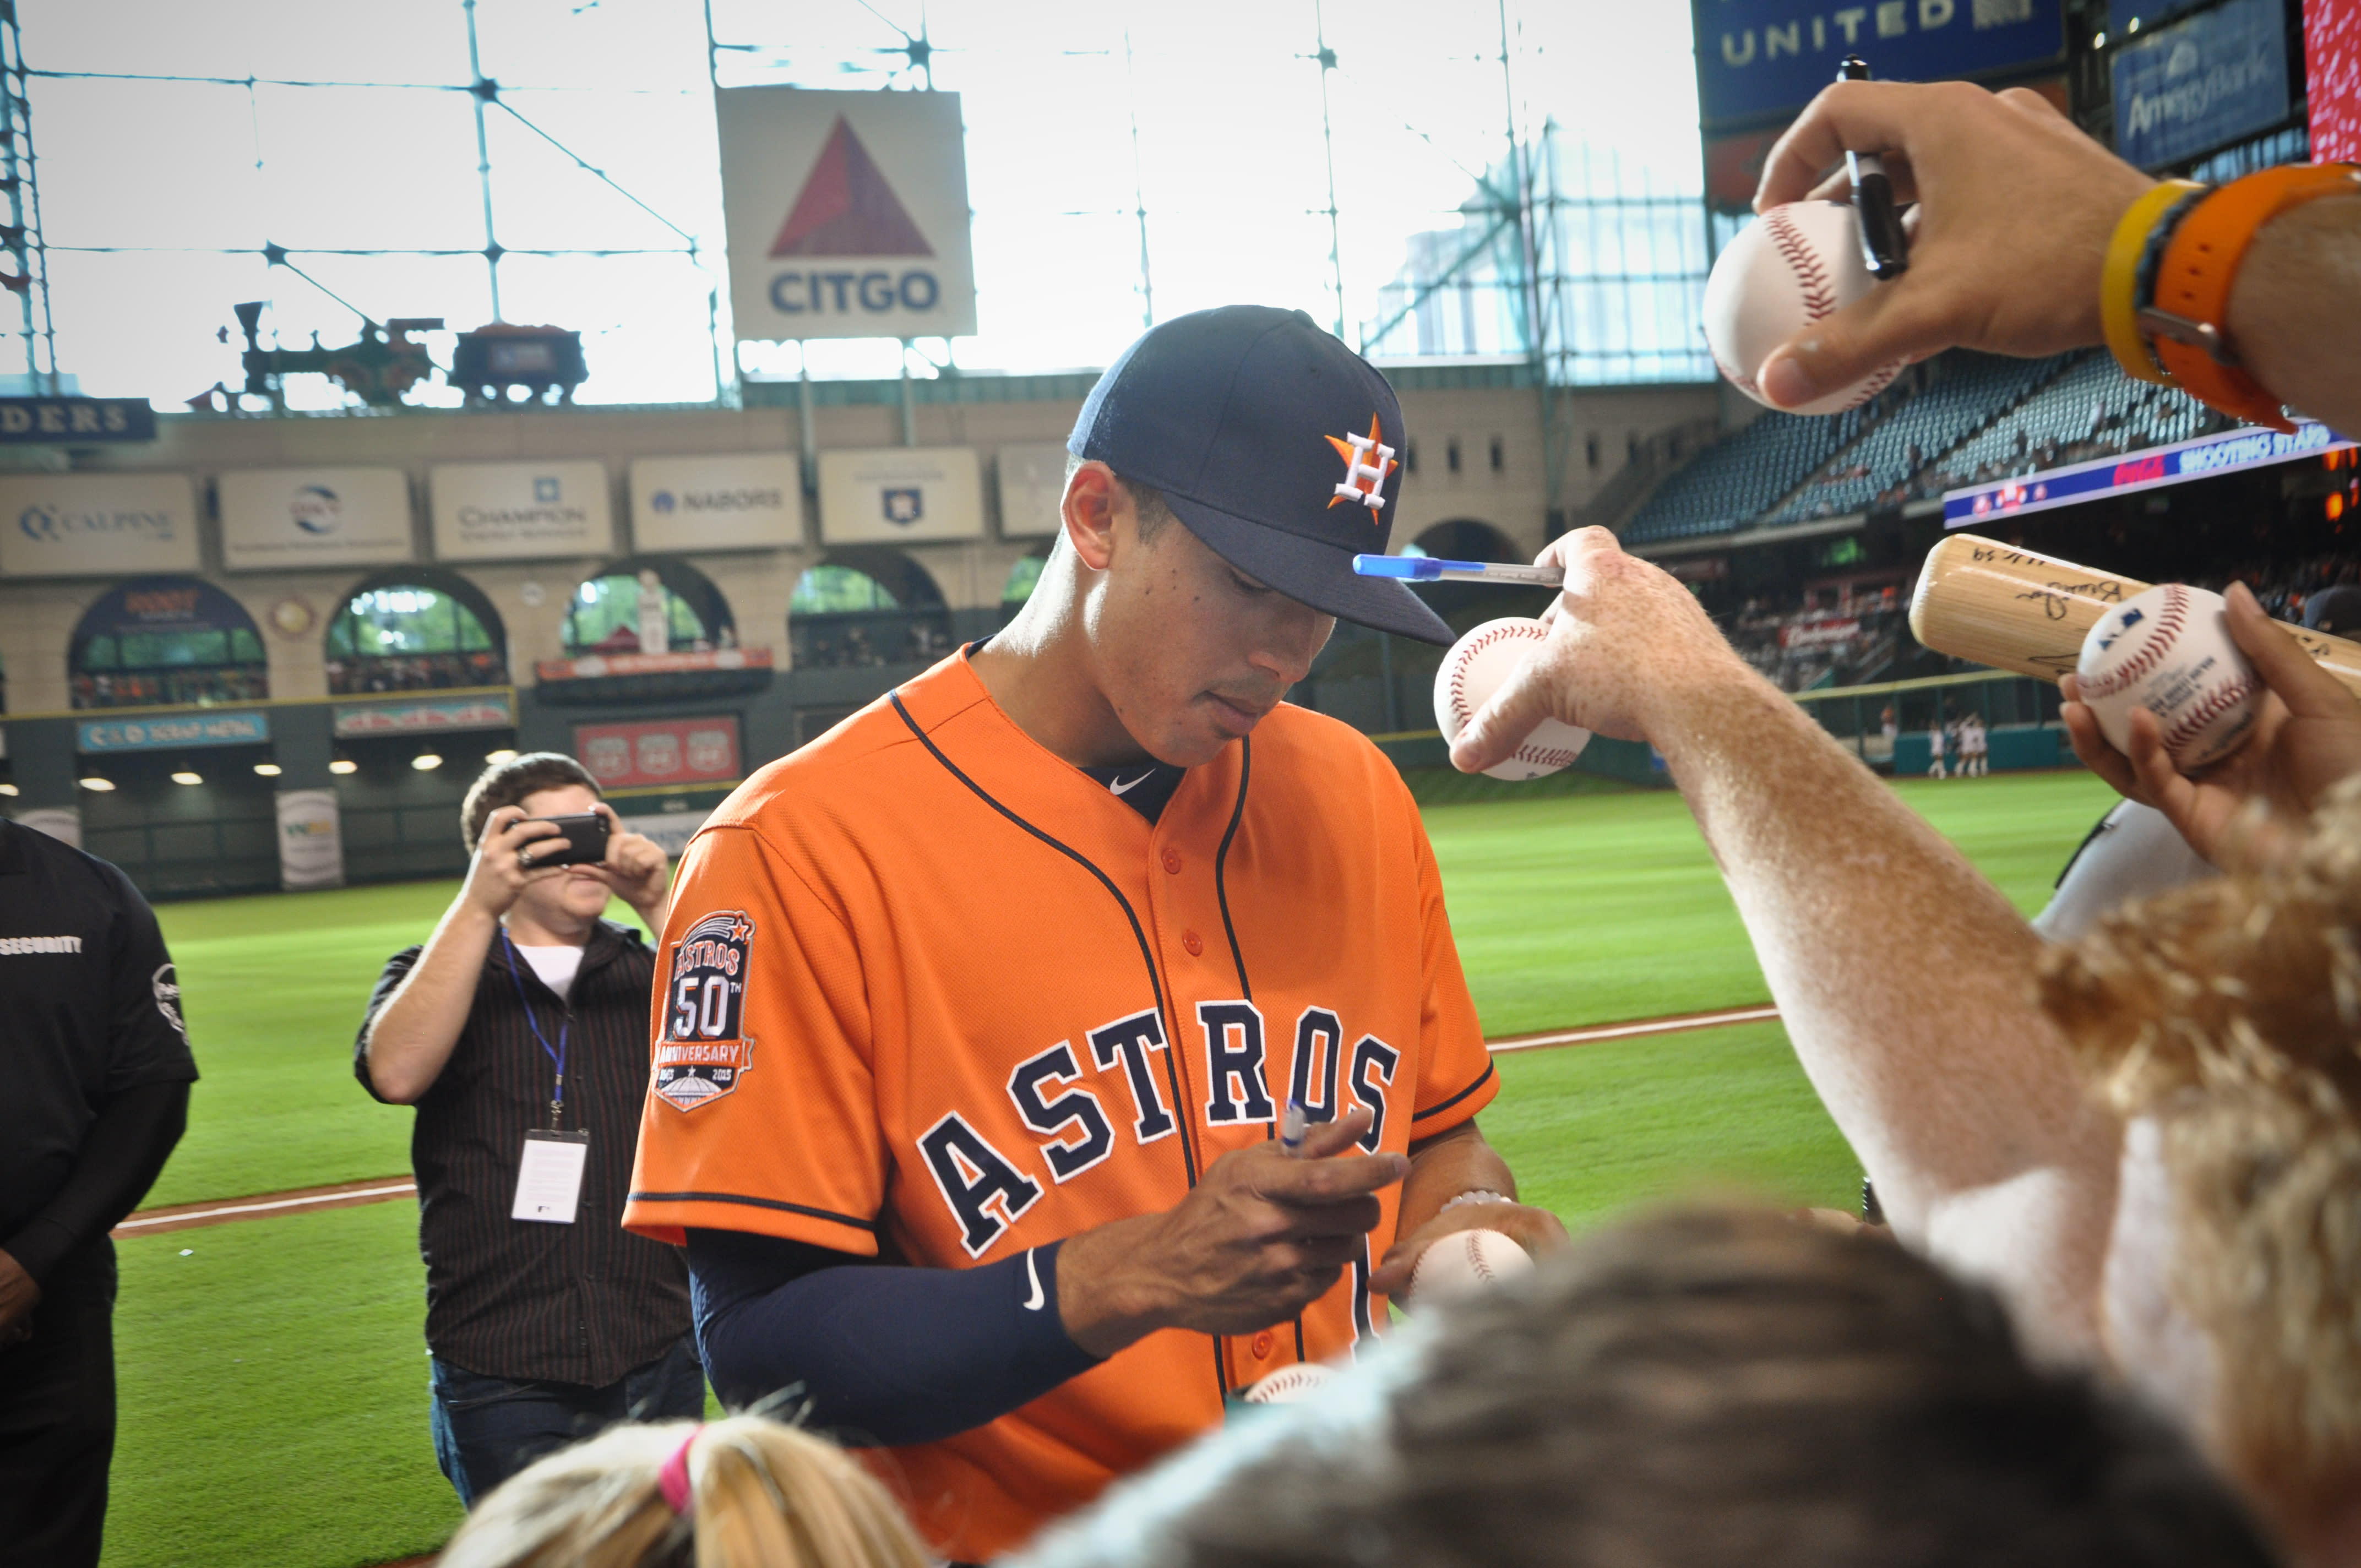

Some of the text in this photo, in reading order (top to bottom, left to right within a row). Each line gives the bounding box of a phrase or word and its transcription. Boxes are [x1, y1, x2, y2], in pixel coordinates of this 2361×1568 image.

[1722, 0, 1955, 66] UNITED
[769, 268, 940, 314] CITGO
[1334, 431, 1395, 510] H
[2179, 432, 2272, 474] SHOOTING
[683, 488, 781, 511] NABORS
[0, 936, 82, 955] SECURITY
[673, 940, 740, 982] ASTROS
[659, 1044, 740, 1064] ANNIVERSARY
[916, 999, 1401, 1260] ASTROS
